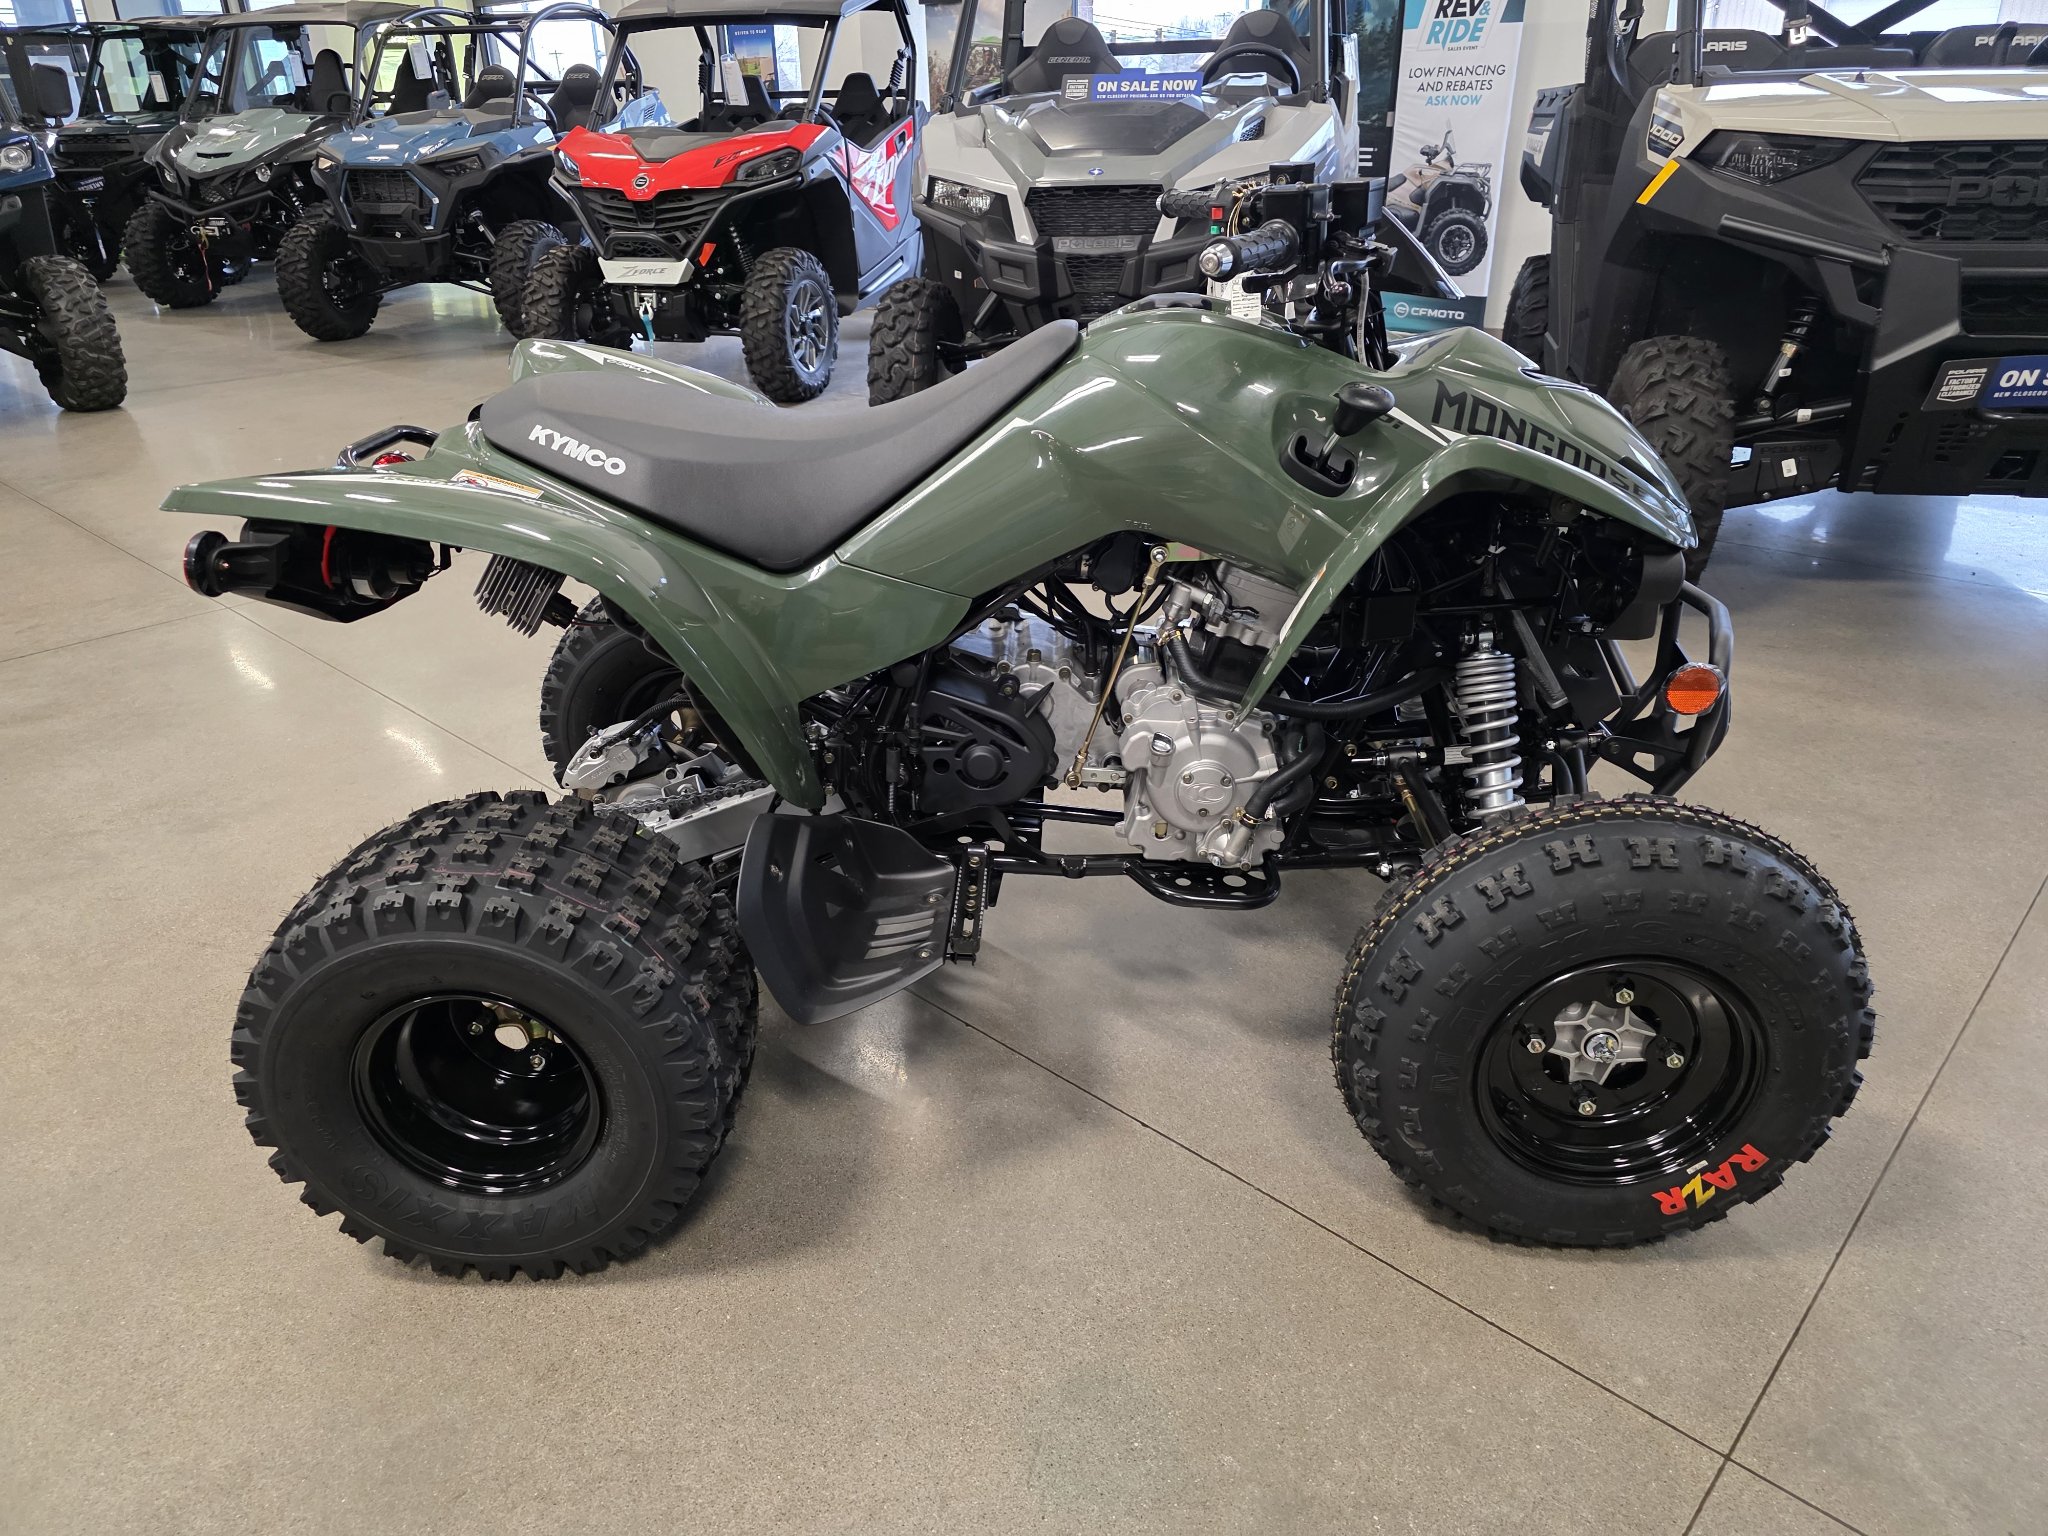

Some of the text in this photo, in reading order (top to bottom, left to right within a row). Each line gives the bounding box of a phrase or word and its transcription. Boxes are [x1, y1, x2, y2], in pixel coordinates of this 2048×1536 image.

[1434, 0, 1484, 19] REV
[1425, 18, 1488, 51] RIDE
[1408, 64, 1507, 79] LOW FINANCING
[1097, 79, 1198, 92] ON SALE NOW
[1416, 79, 1494, 93] AND REBATES
[1425, 94, 1483, 106] ASK NOW
[1650, 124, 1683, 145] 1000
[1057, 238, 1135, 249] POLARIS
[1410, 306, 1465, 320] CFMOTO
[1948, 377, 1979, 385] FACTORY
[2000, 369, 2041, 388] ON
[528, 424, 626, 475] KYMCO
[1651, 1143, 1770, 1215] RAZR
